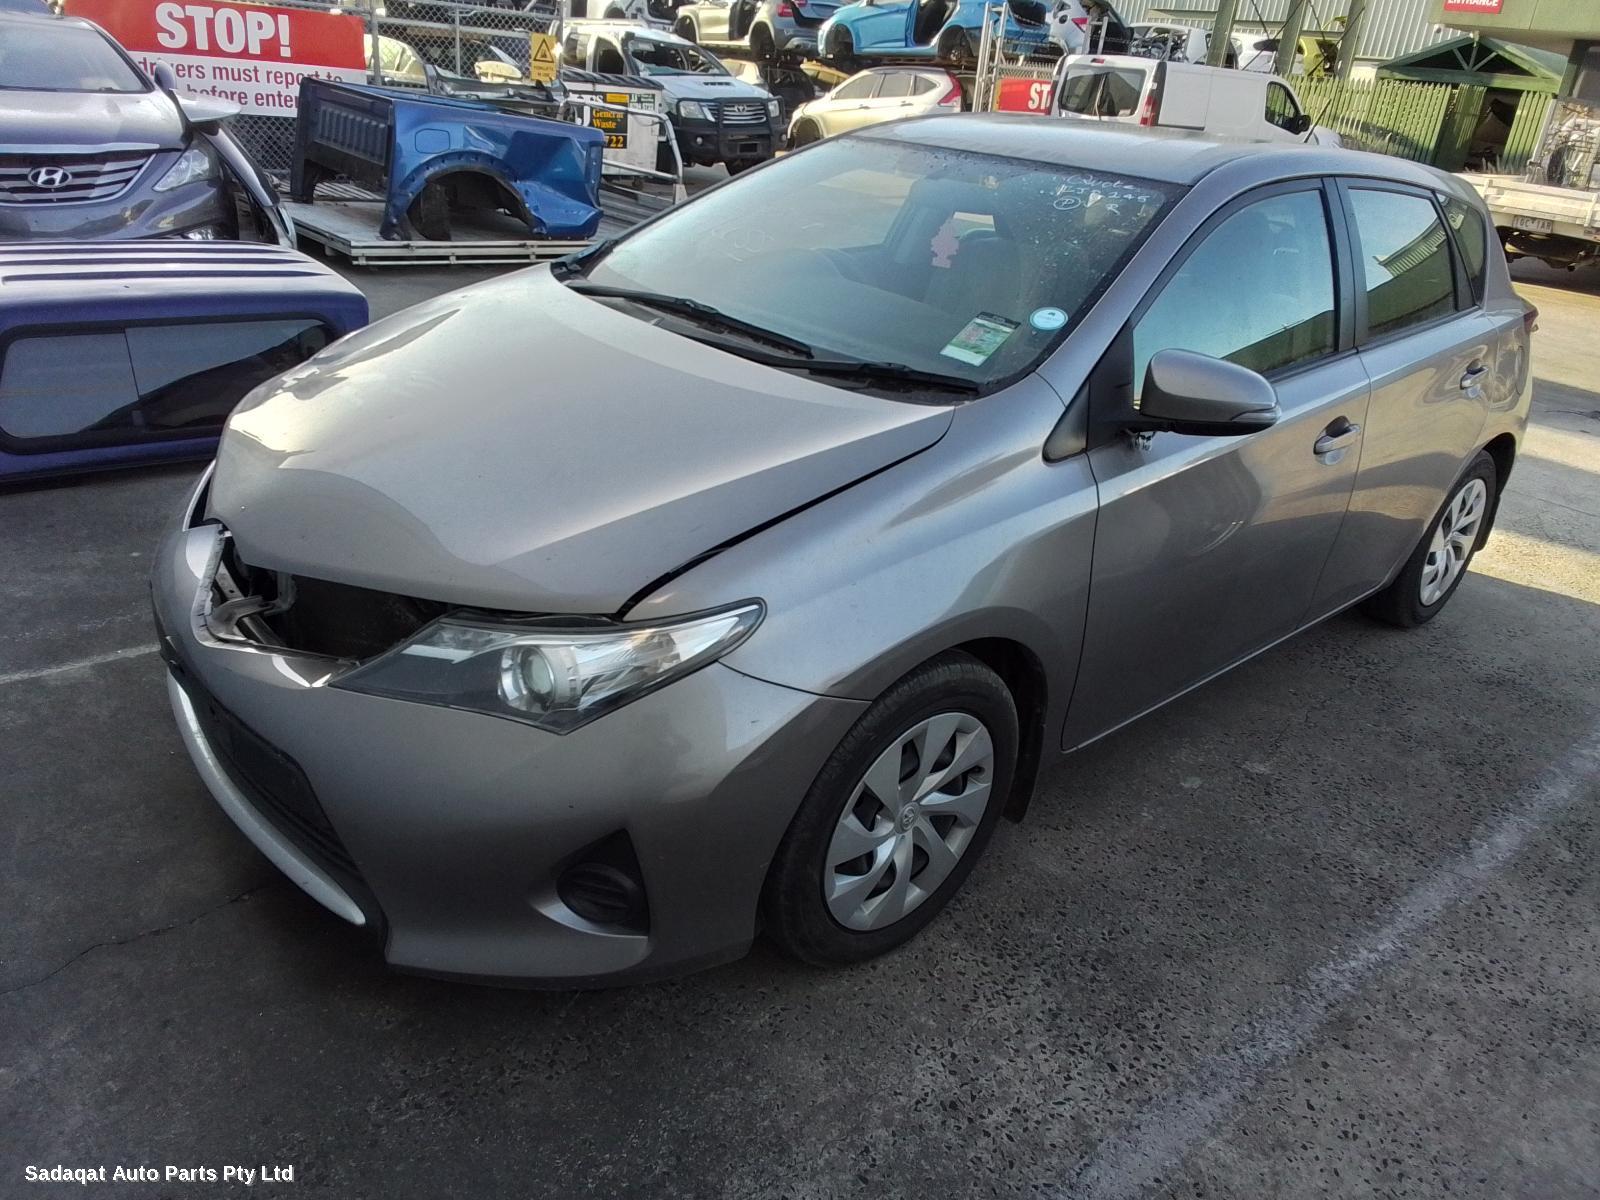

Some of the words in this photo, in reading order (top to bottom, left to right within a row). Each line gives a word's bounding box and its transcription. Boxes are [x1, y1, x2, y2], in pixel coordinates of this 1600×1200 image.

[156, 2, 291, 58] STOP!
[138, 57, 205, 80] drers
[212, 66, 260, 83] must
[1028, 82, 1051, 110] ST
[592, 120, 617, 129] Waste
